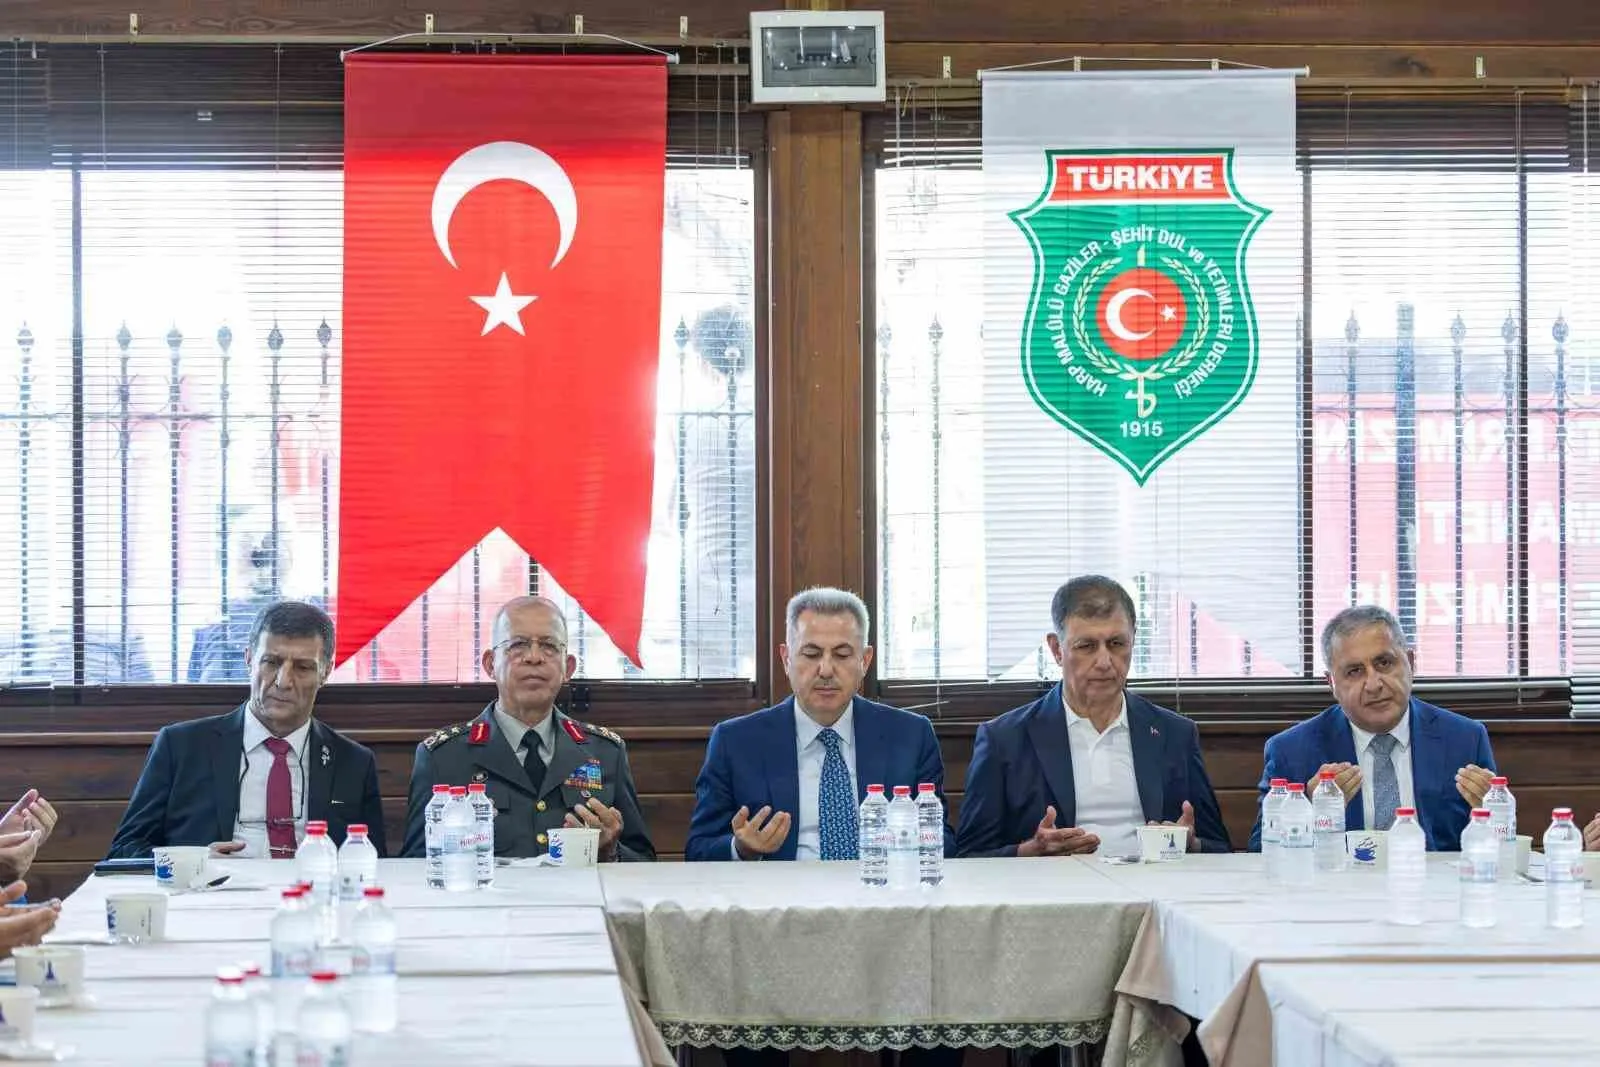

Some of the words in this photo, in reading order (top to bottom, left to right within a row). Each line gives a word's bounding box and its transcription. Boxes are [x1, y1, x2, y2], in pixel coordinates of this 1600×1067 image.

[1066, 163, 1214, 191] TÜRKİYE
[1110, 223, 1156, 249] ŞEHİT
[1157, 228, 1186, 252] DUL
[1053, 240, 1102, 296] GAZİLER
[1188, 245, 1205, 264] ve
[1203, 258, 1235, 341] YETİMLERİ
[1067, 365, 1108, 397] HARP
[1174, 341, 1228, 400] DERNEĞİ
[1119, 421, 1163, 437] 1915
